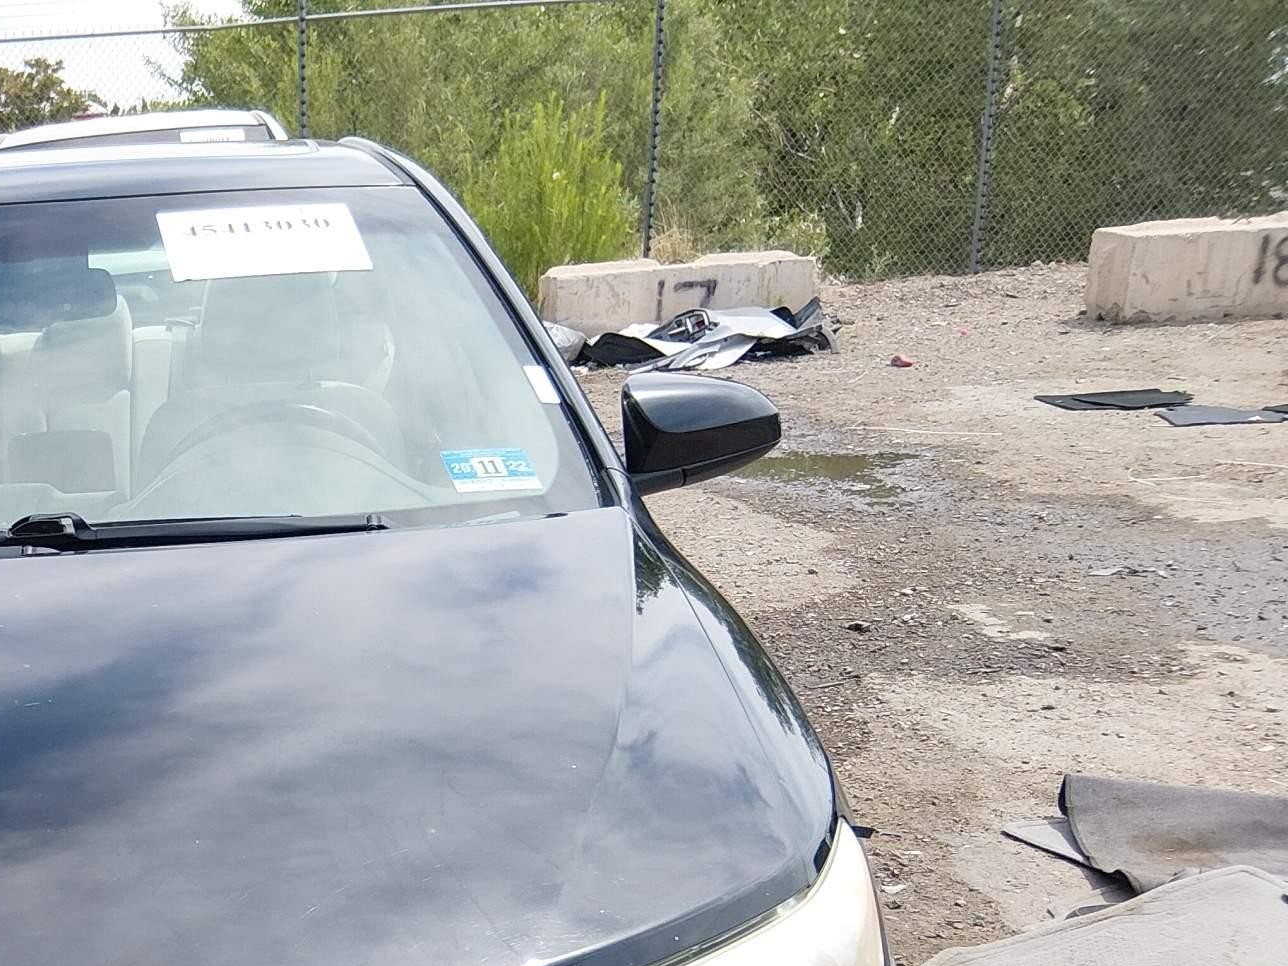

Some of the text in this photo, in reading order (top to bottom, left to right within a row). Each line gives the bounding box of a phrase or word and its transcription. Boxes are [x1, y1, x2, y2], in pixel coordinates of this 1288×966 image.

[182, 217, 331, 237] 45413030
[655, 278, 718, 322] 17
[477, 459, 503, 475] 11
